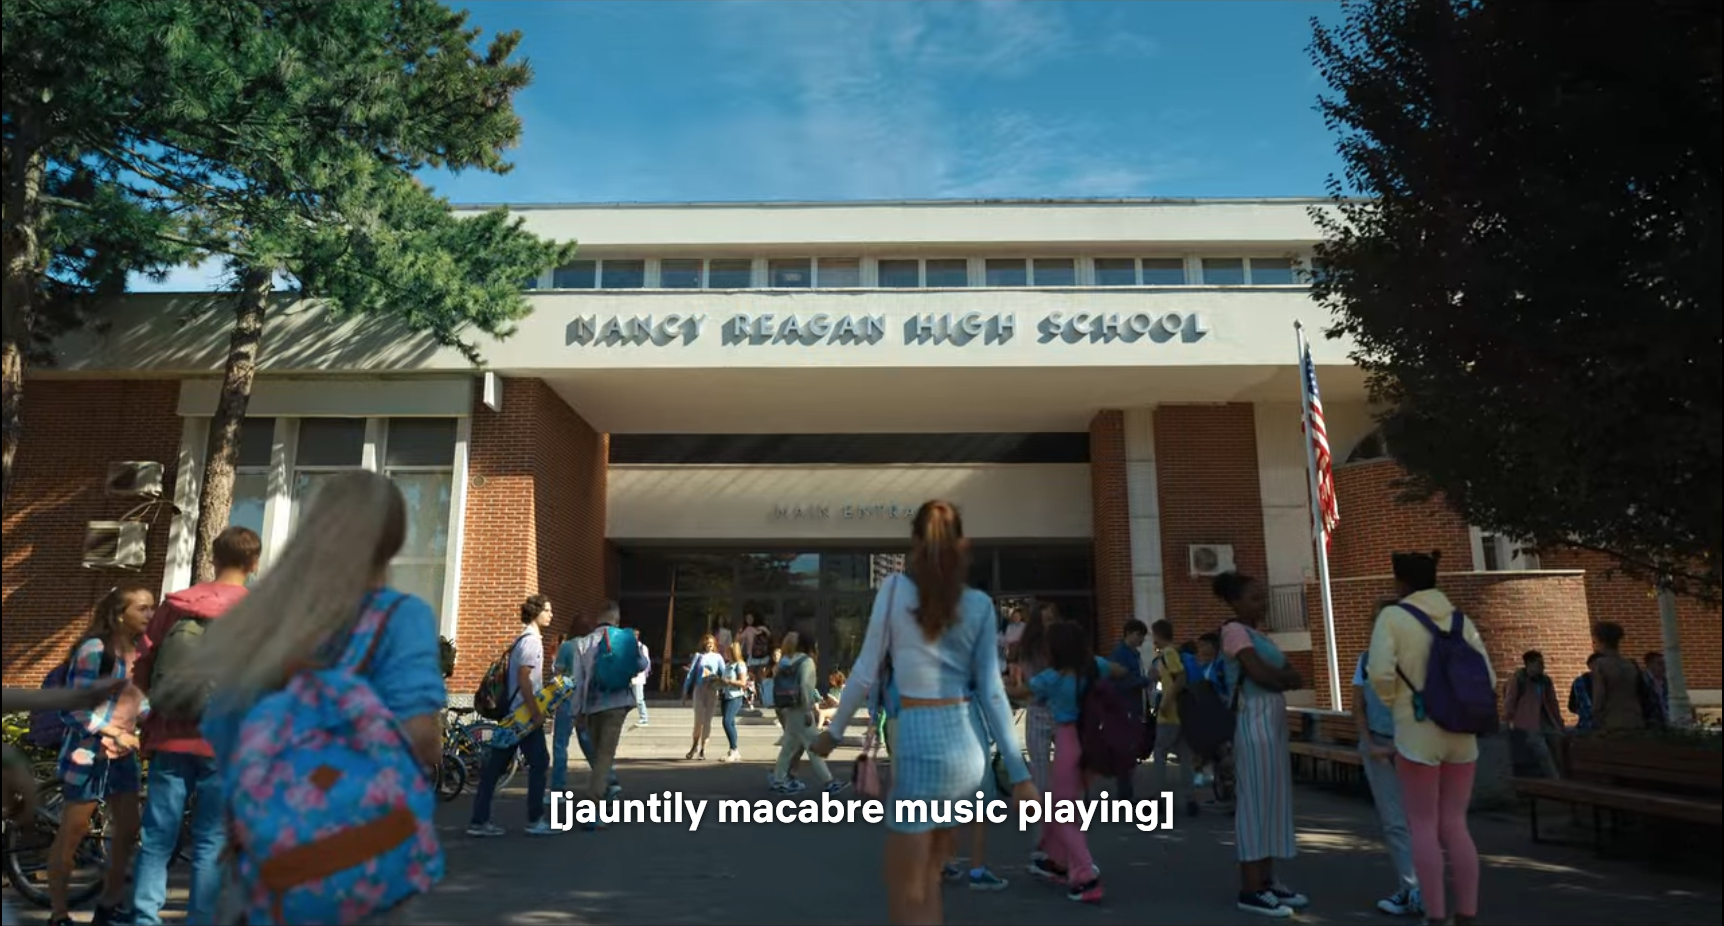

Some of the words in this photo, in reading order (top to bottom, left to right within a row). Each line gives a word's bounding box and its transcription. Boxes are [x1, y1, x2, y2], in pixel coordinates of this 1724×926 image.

[570, 313, 706, 342] NANCY
[727, 313, 886, 342] REAGAN
[908, 311, 1014, 341] HIGH
[1042, 310, 1210, 340] SCHOOL
[774, 505, 830, 519] MAIN
[844, 504, 920, 519] ENTRA
